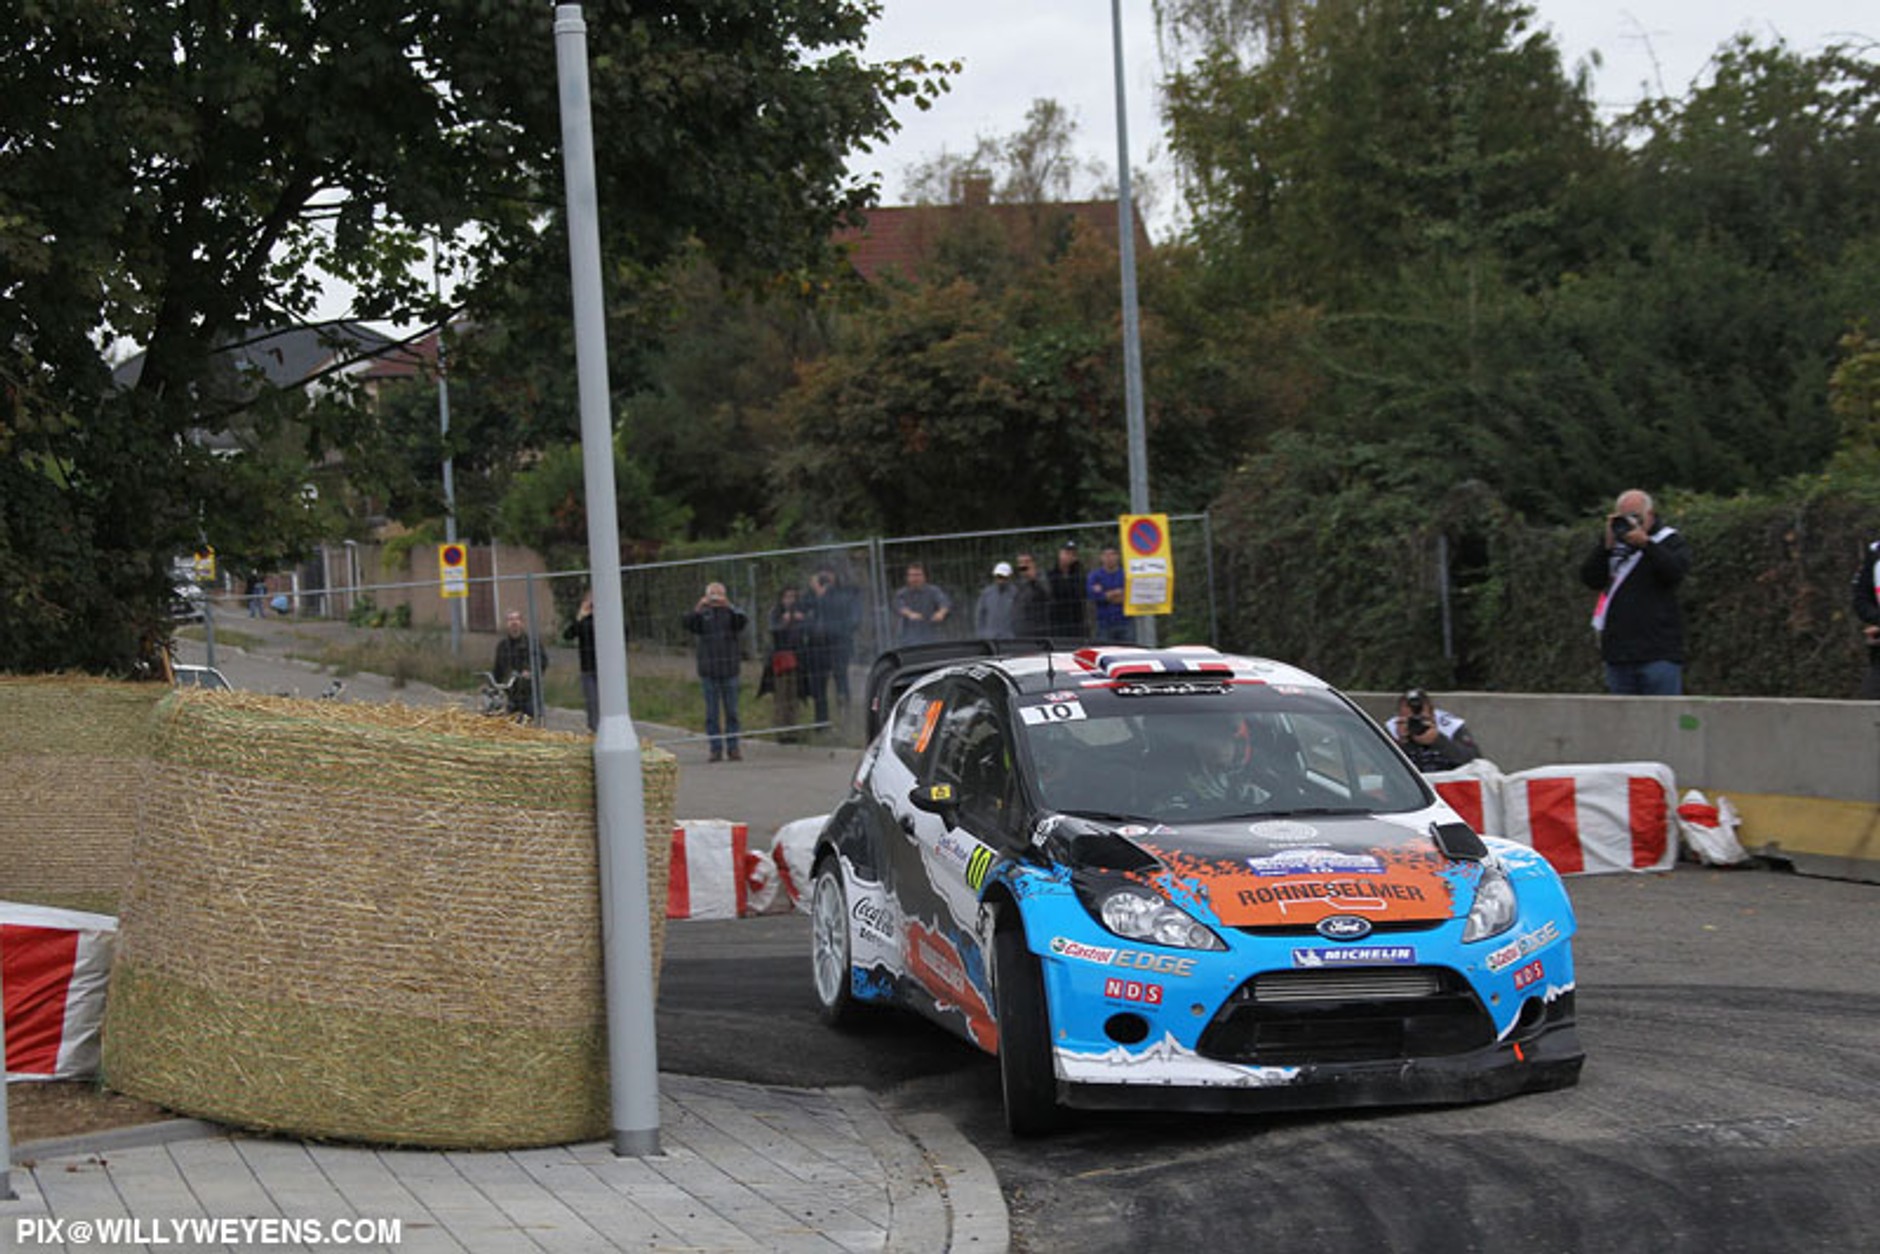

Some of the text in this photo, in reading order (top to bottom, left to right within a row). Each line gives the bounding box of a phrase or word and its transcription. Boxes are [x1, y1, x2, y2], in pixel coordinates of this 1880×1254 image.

[1035, 703, 1073, 721] 10
[967, 846, 993, 892] 10
[1328, 919, 1361, 933] Ford
[1064, 942, 1199, 977] Castrol EDGE
[1324, 948, 1411, 960] MICHELIN
[1106, 979, 1161, 1003] NDS
